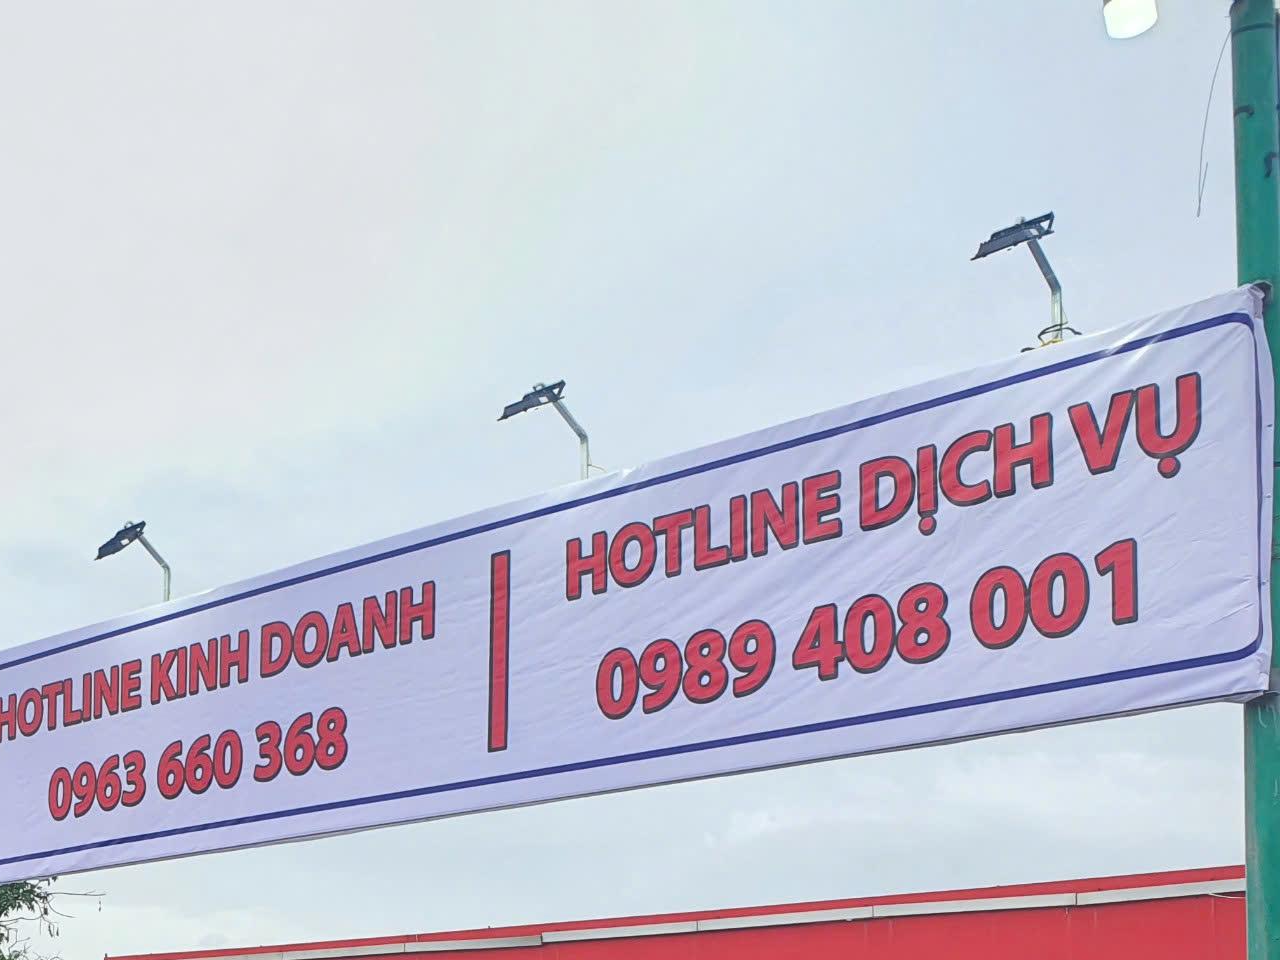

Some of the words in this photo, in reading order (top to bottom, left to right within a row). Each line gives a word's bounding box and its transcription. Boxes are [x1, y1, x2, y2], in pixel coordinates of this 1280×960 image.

[564, 469, 842, 601] HOTLINE
[858, 411, 1053, 536] DỊCH
[1067, 371, 1202, 478] VỤ
[150, 629, 250, 704] KINH
[260, 580, 436, 679] DOANH
[595, 618, 777, 720] 0989
[792, 581, 950, 681] 408
[969, 537, 1139, 650] 001
[48, 748, 146, 821] 0963
[157, 729, 243, 800] 660
[254, 706, 348, 783] 368
